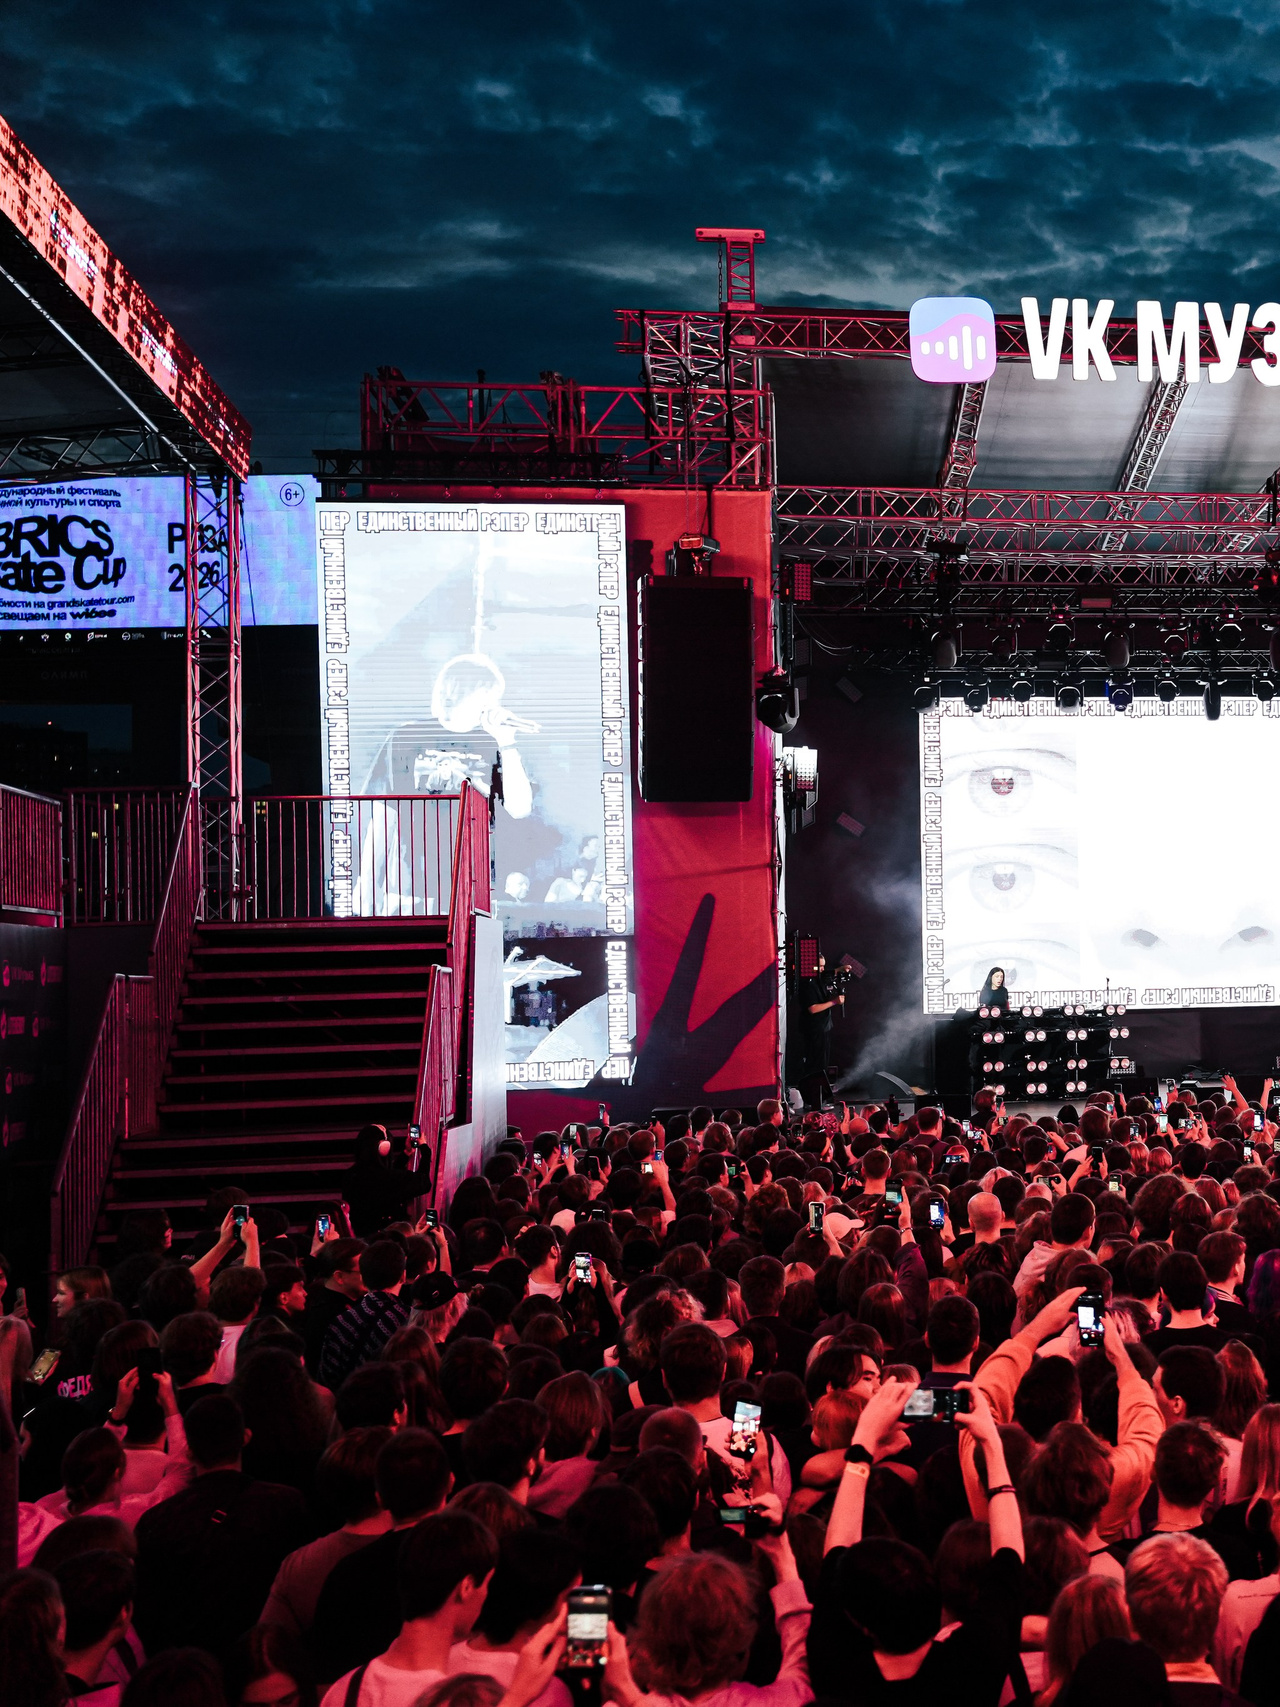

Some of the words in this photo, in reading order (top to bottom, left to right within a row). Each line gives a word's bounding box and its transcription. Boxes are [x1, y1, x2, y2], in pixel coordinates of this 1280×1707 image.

[1021, 297, 1118, 382] VK
[25, 499, 77, 509] культуры
[88, 499, 122, 509] спорта
[67, 485, 121, 497] фестиваль
[357, 509, 478, 533] ЕДИНСТВЕННЫЙ
[481, 511, 529, 532] РЭПЕР
[320, 538, 349, 653] ЕДИНСТВЕННЫЙ
[598, 553, 619, 600] РЭПЕР
[33, 601, 46, 609] на
[53, 611, 67, 621] на
[326, 659, 348, 706] РЭПЕР
[597, 605, 625, 720] ЕДИНСТВЕННЫЙ
[602, 720, 623, 768] РЭПЕР
[601, 771, 628, 886] ЕДИНСТВЕННЫЙ
[605, 941, 631, 1055] ЕДИНСТВЕННЫЙ
